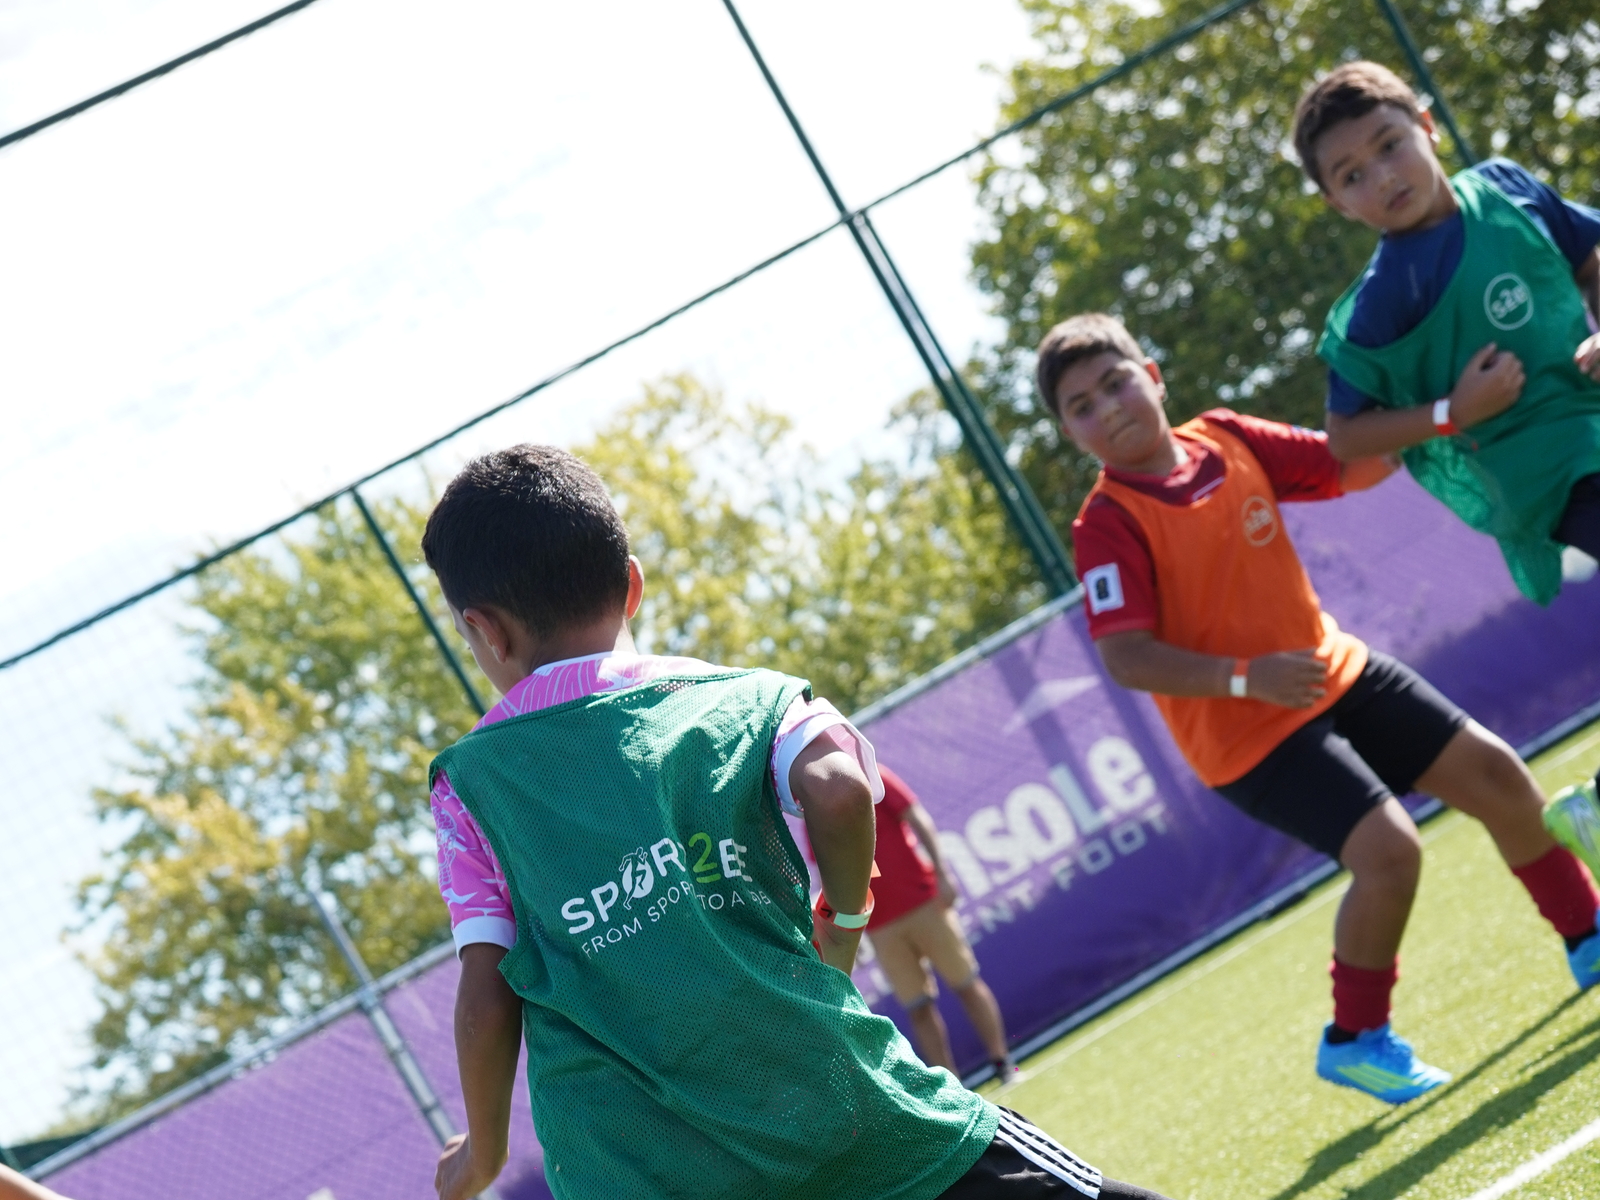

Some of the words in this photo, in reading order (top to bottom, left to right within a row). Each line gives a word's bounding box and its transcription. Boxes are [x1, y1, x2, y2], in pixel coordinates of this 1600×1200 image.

[1054, 801, 1168, 891] FOOT
[581, 916, 643, 960] FROM
[697, 893, 724, 910] TO
